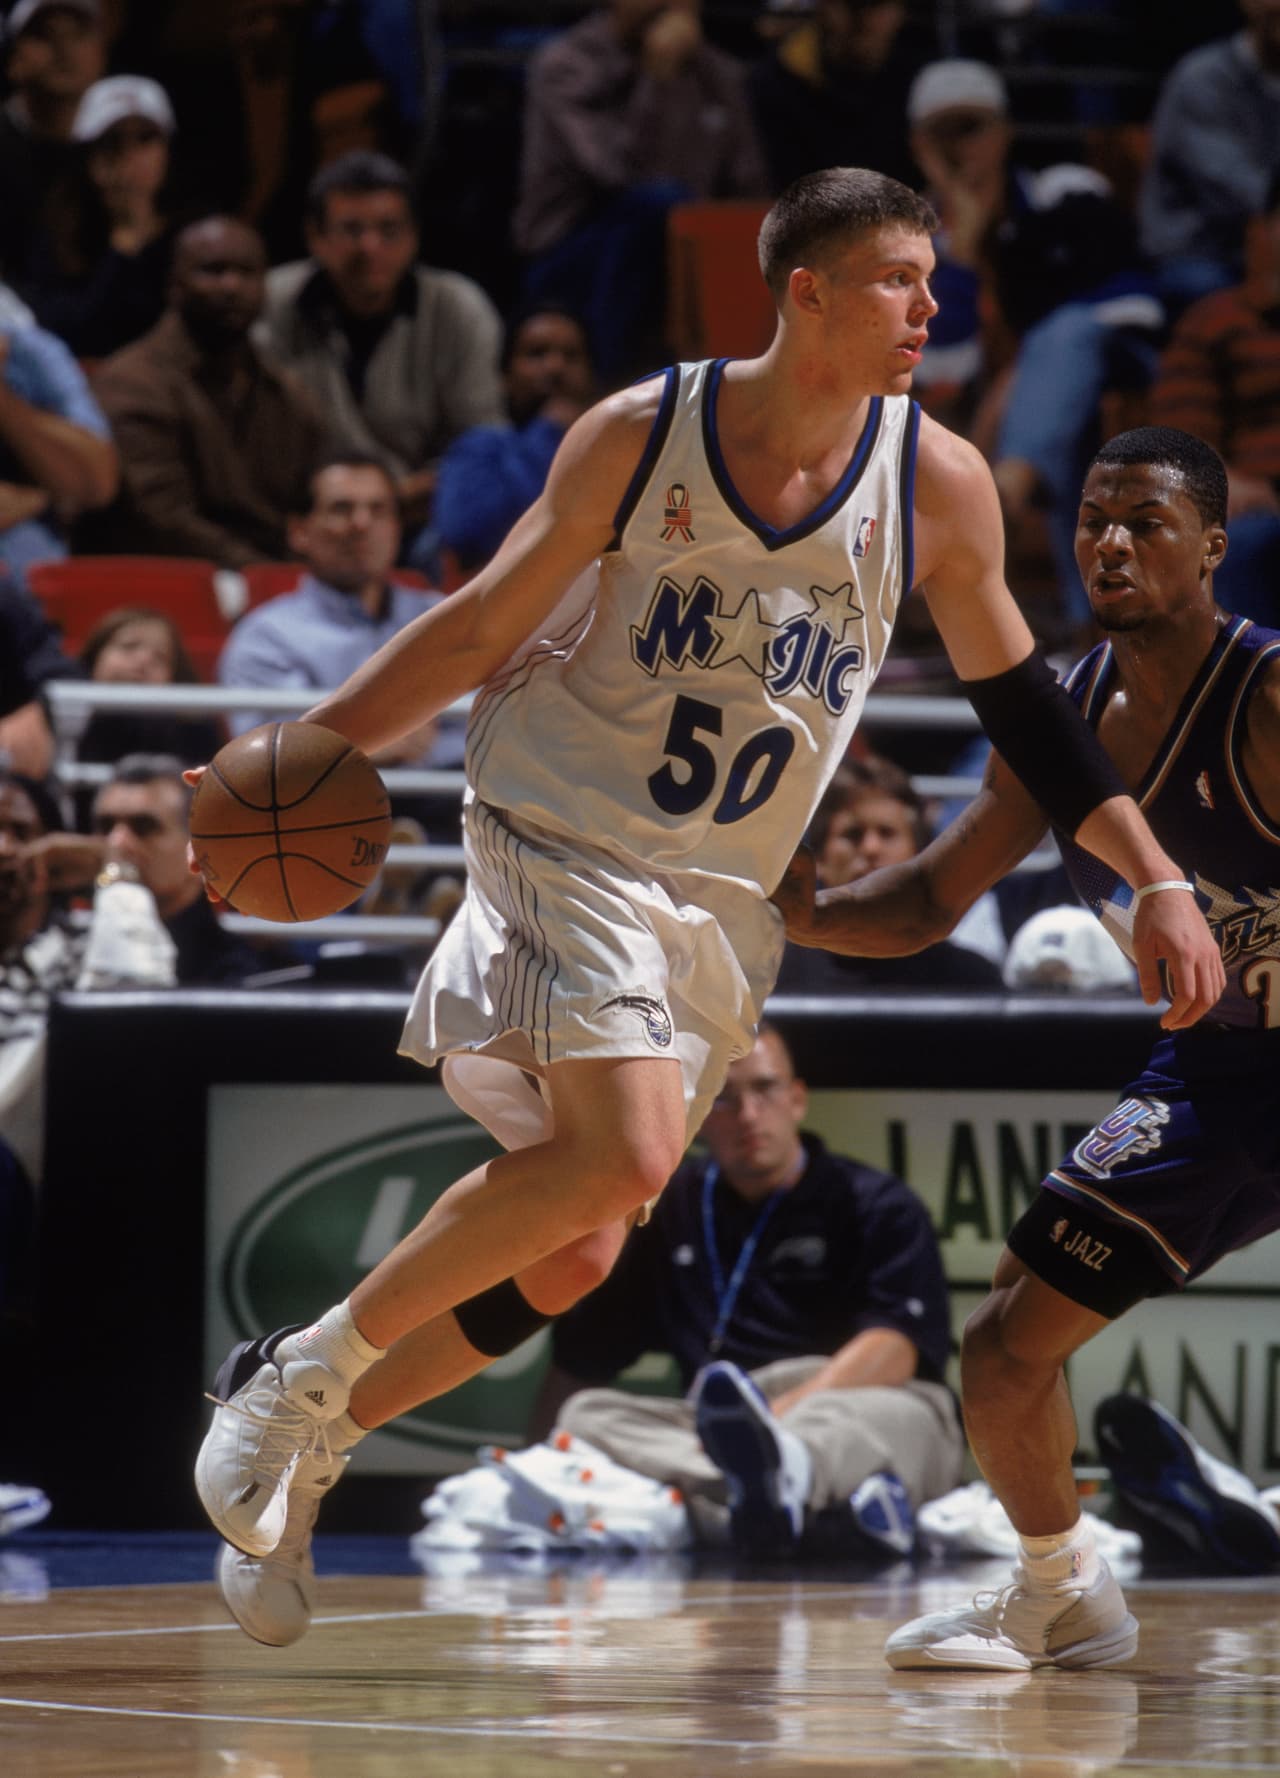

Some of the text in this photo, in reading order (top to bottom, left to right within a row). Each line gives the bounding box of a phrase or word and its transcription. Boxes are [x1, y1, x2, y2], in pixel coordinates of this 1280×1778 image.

[647, 694, 796, 825] 50
[886, 1118, 1099, 1241] AN
[1063, 1230, 1113, 1272] JAZZ
